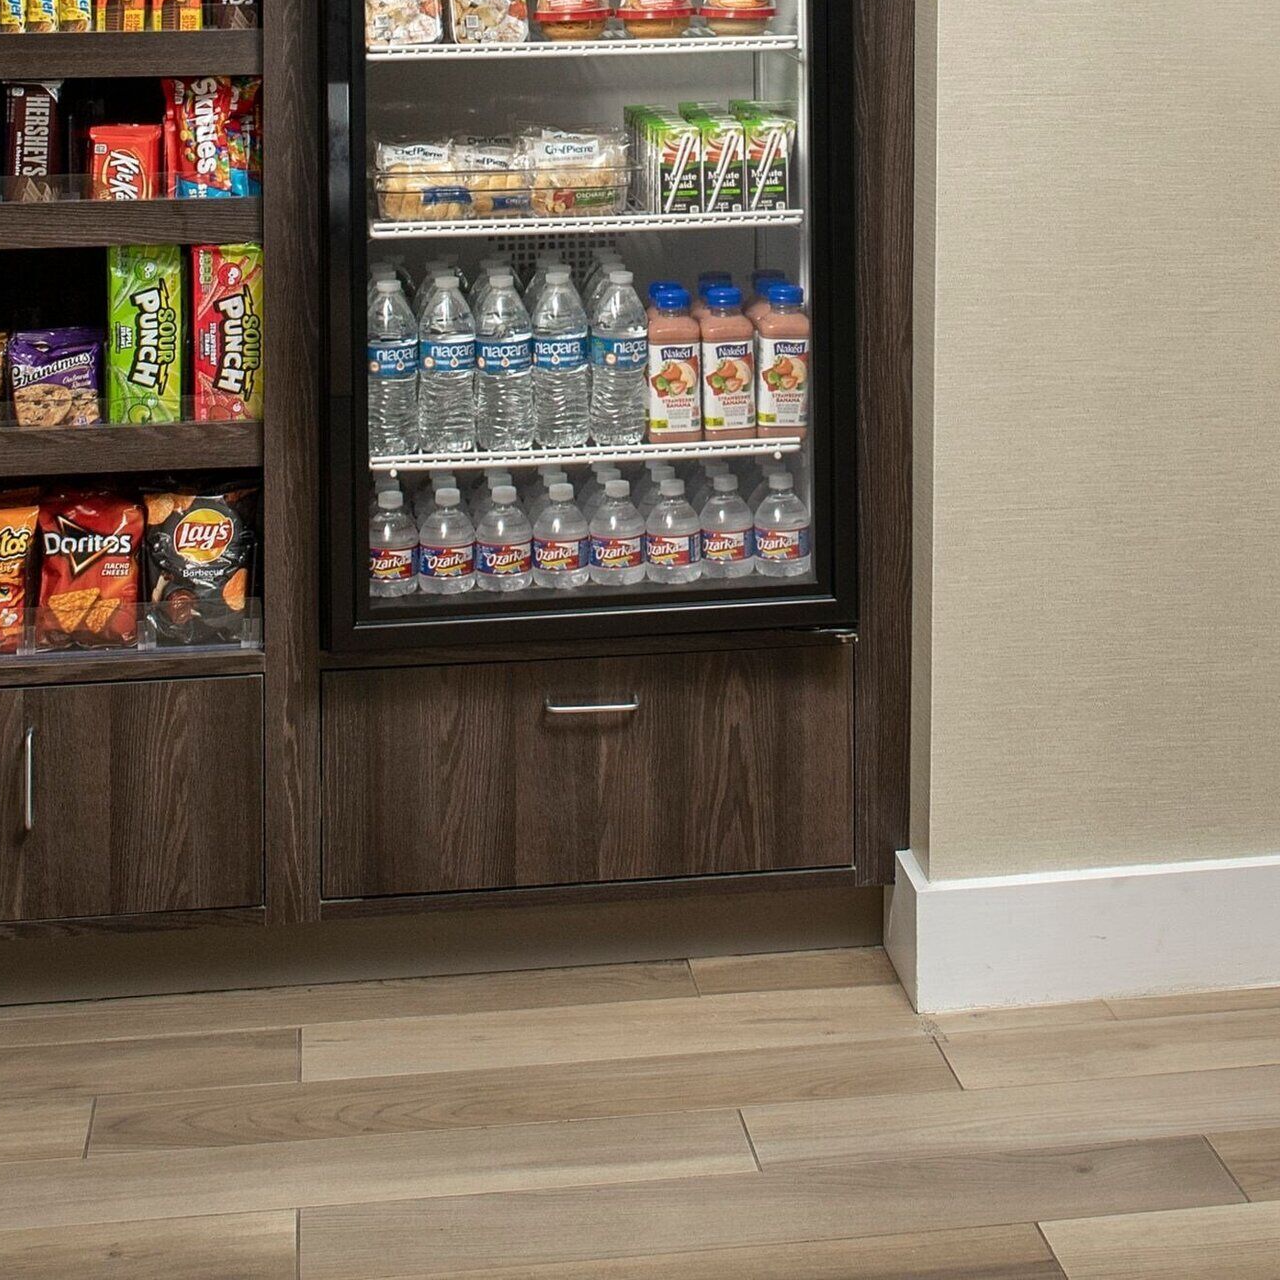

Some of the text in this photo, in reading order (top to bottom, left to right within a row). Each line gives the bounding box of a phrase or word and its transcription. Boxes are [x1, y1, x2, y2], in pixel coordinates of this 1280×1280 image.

[191, 78, 218, 174] Skittles
[23, 97, 50, 177] HERSHEY'S
[132, 288, 161, 387] PUNCH
[158, 308, 176, 364] SOUR
[219, 296, 245, 394] PUNCH
[242, 314, 261, 371] SOUR
[483, 342, 528, 361] niagara
[535, 340, 580, 358] niagara
[45, 533, 132, 554] Doritos
[178, 521, 231, 550] Lay's
[757, 536, 793, 551] Ozarka
[427, 552, 466, 569] Ozarka
[486, 551, 525, 567] Ozarka
[535, 546, 574, 561] Ozarka
[595, 543, 634, 560] Ozarka
[183, 568, 224, 578] Barbecue
